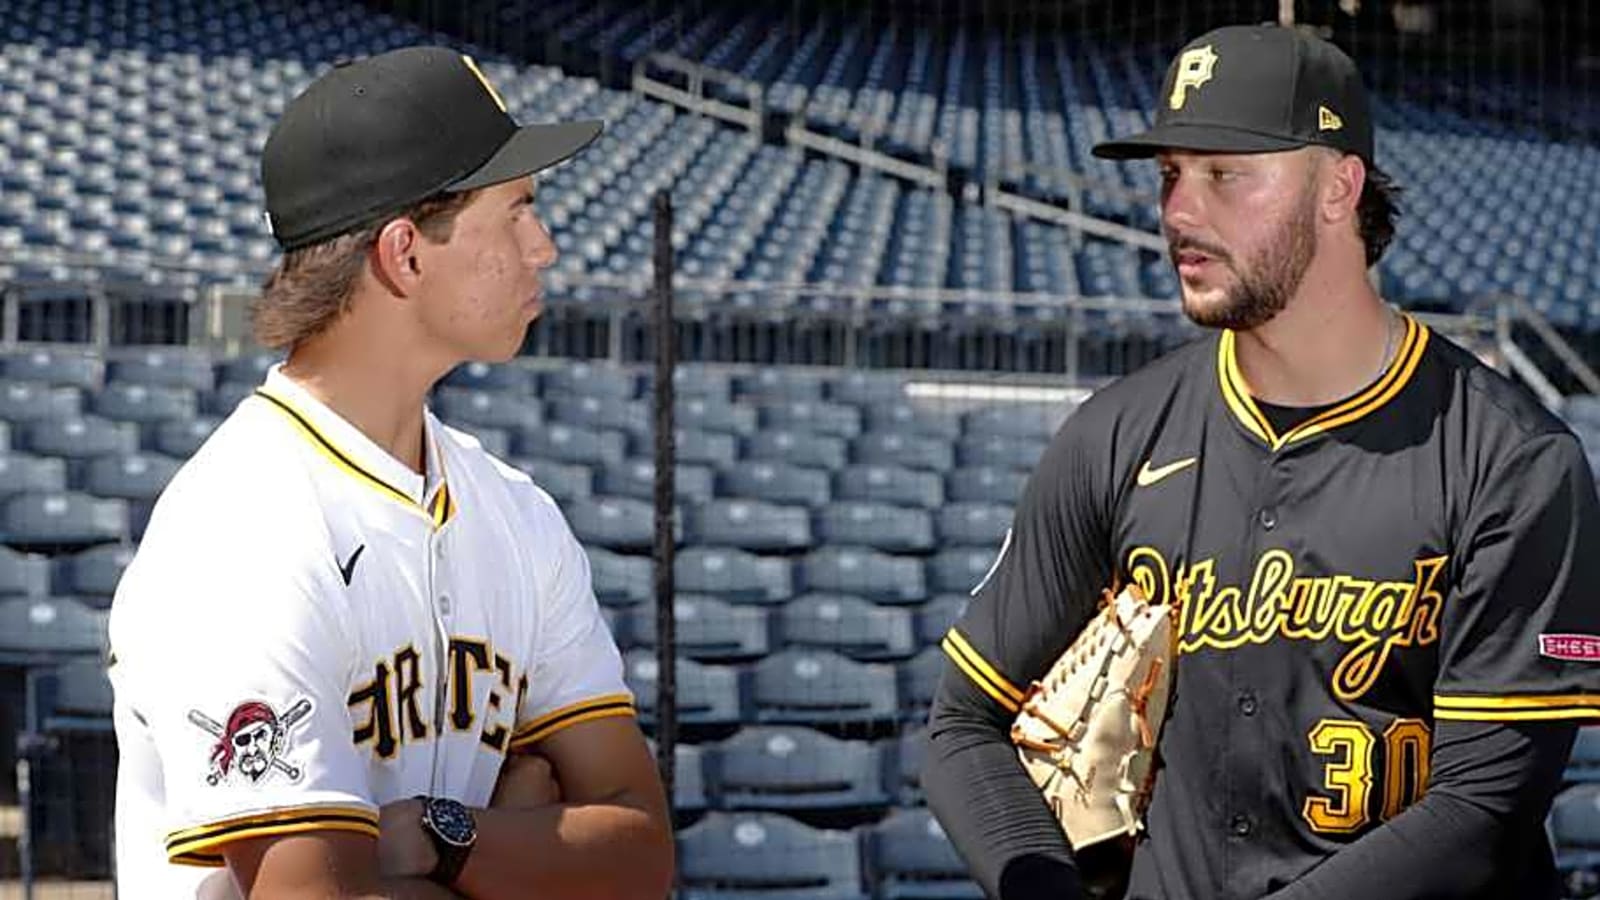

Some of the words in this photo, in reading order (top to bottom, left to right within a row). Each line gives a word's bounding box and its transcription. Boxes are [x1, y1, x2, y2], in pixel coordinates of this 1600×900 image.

[1170, 45, 1218, 110] P
[1128, 547, 1449, 700] Ptsburgh
[1545, 638, 1600, 656] SHEE
[347, 634, 528, 759] IRTE
[1303, 718, 1431, 833] 30
